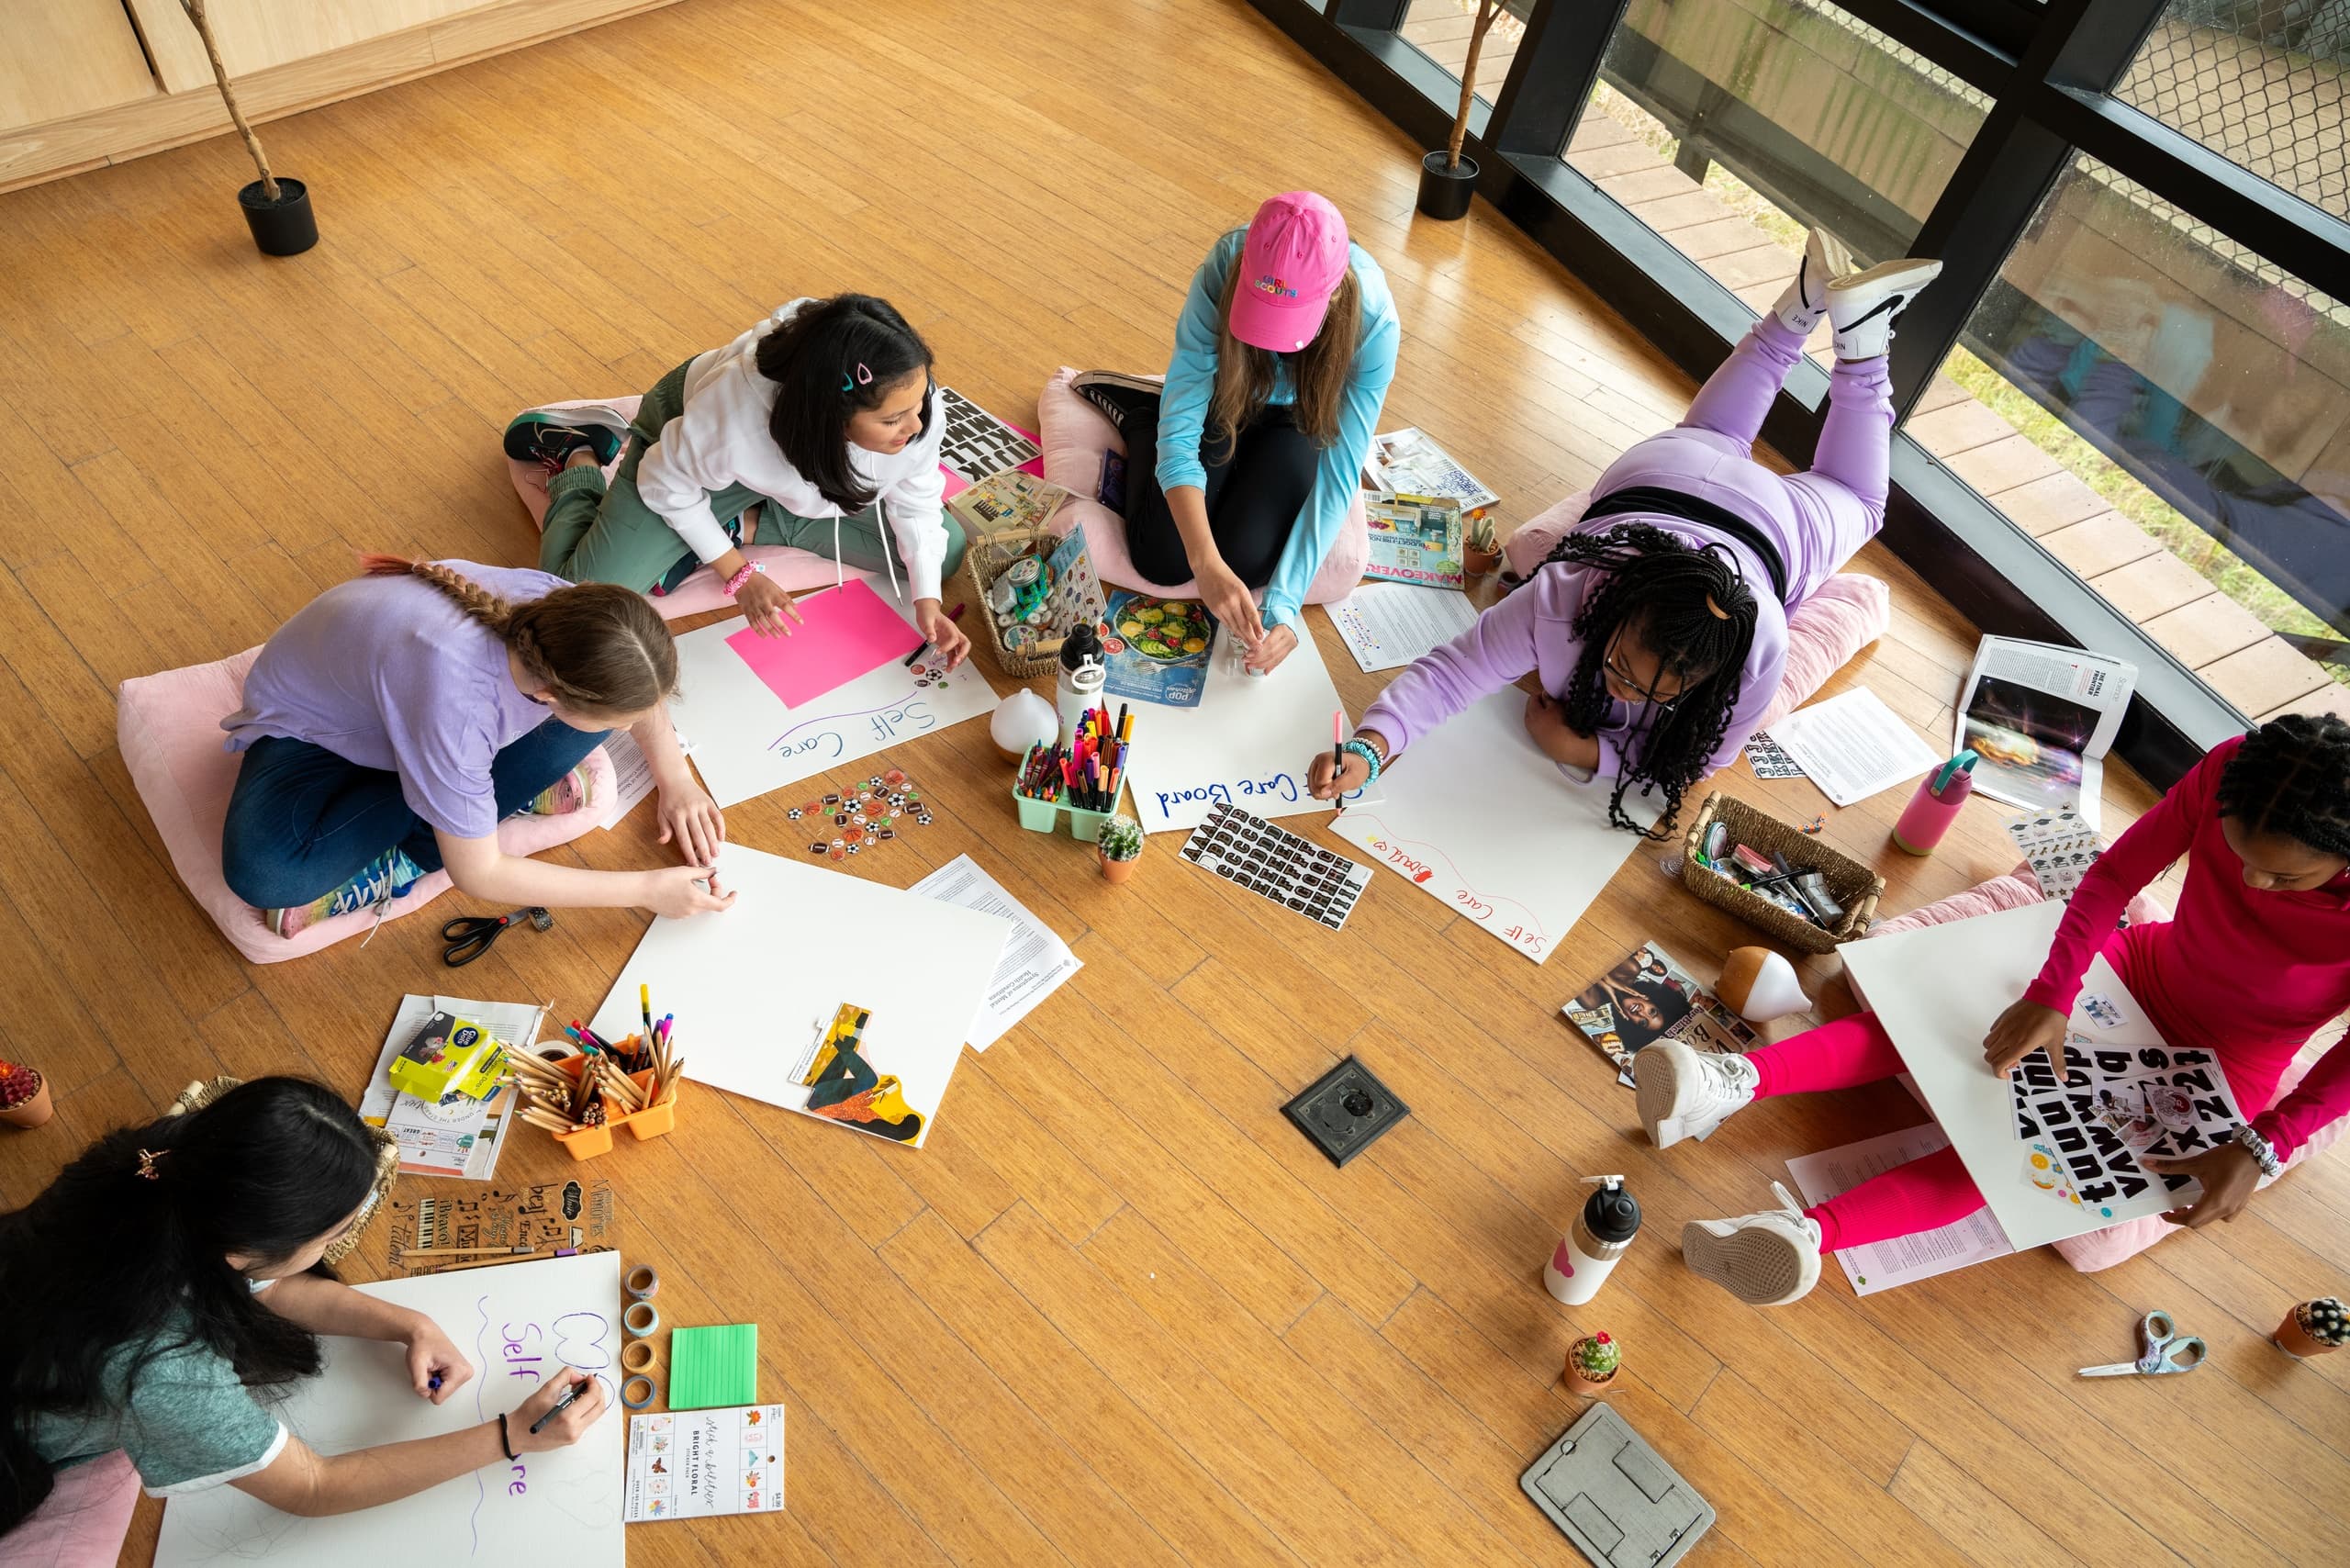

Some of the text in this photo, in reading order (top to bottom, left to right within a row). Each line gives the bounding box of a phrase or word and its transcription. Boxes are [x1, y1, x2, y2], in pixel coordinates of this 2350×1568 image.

[1254, 279, 1298, 298] SCOUTS
[1792, 314, 1808, 328] NIKE
[1168, 690, 1189, 700] POP
[2087, 669, 2099, 696] FRONTIER
[2092, 681, 2102, 698] FINAL
[779, 701, 936, 757] Self Care
[1156, 783, 1232, 818] Board
[1237, 773, 1298, 801] Care
[1207, 813, 1225, 827] A
[1222, 820, 1241, 834] B
[1240, 828, 1259, 842] C
[1256, 837, 1276, 852] D
[1273, 845, 1294, 860] E
[1291, 852, 1309, 868] F
[1309, 862, 1328, 875] G
[1325, 868, 1347, 885] H
[1214, 802, 1353, 873] A B C D E F G H
[1191, 836, 1211, 850] A
[1206, 843, 1225, 858] B
[1225, 852, 1243, 866] C
[1240, 860, 1260, 876] D
[1258, 868, 1279, 884] E
[1275, 876, 1294, 891] F
[1294, 885, 1314, 899] G
[1311, 891, 1332, 909] H
[1199, 824, 1218, 838] A
[1214, 831, 1234, 846] B
[1233, 840, 1250, 854] C
[1248, 848, 1268, 864] D
[1266, 856, 1286, 872] E
[1282, 864, 1302, 880] F
[1302, 874, 1321, 887] G
[1318, 879, 1339, 896] H
[1182, 847, 1203, 862] A
[1216, 865, 1235, 878] C
[1232, 872, 1252, 888] D
[1249, 879, 1270, 896] E
[1267, 888, 1286, 904] F
[1286, 898, 1306, 911] G
[1303, 903, 1325, 921] H
[1456, 890, 1494, 921] Care
[1011, 970, 1039, 991] Symptoms
[1013, 969, 1032, 984] Health
[987, 980, 1015, 1001] Conditions
[989, 993, 1008, 1009] Mental
[456, 1028, 471, 1047] Dots
[462, 1028, 476, 1047] Glue
[1663, 1014, 1693, 1039] Black
[516, 1183, 560, 1215] beat
[455, 1230, 479, 1263] Muic
[517, 1220, 532, 1247] Enco
[501, 1323, 543, 1497] Self re
[689, 1430, 700, 1495] BRIGHT FLORAL
